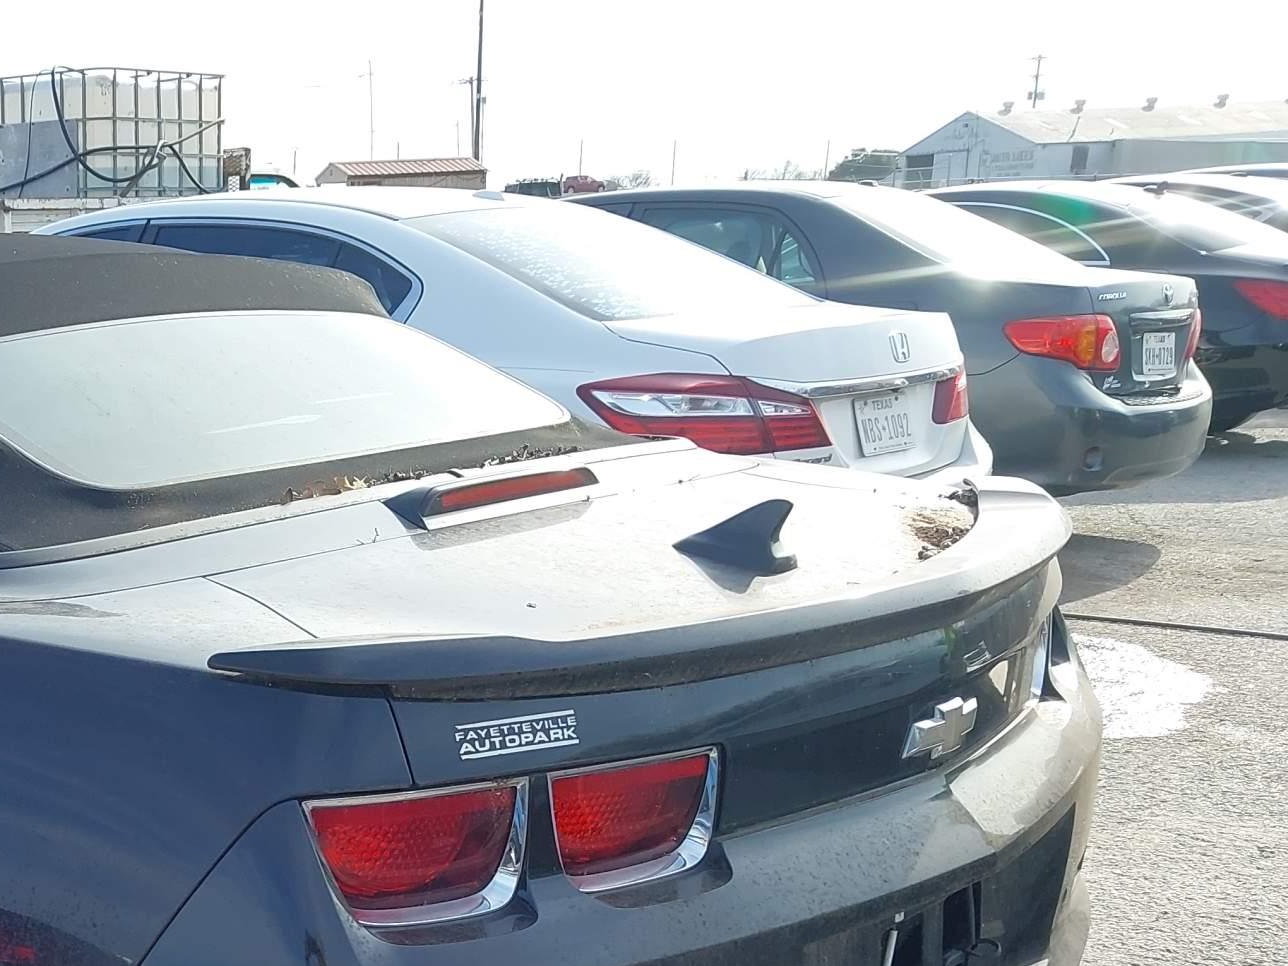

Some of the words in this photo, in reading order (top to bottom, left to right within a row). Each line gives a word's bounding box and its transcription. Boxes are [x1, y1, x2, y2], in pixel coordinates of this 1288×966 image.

[872, 398, 893, 411] TEXAS
[454, 716, 577, 742] FAYETTEVILLE
[459, 727, 578, 754] AUTOPARK
